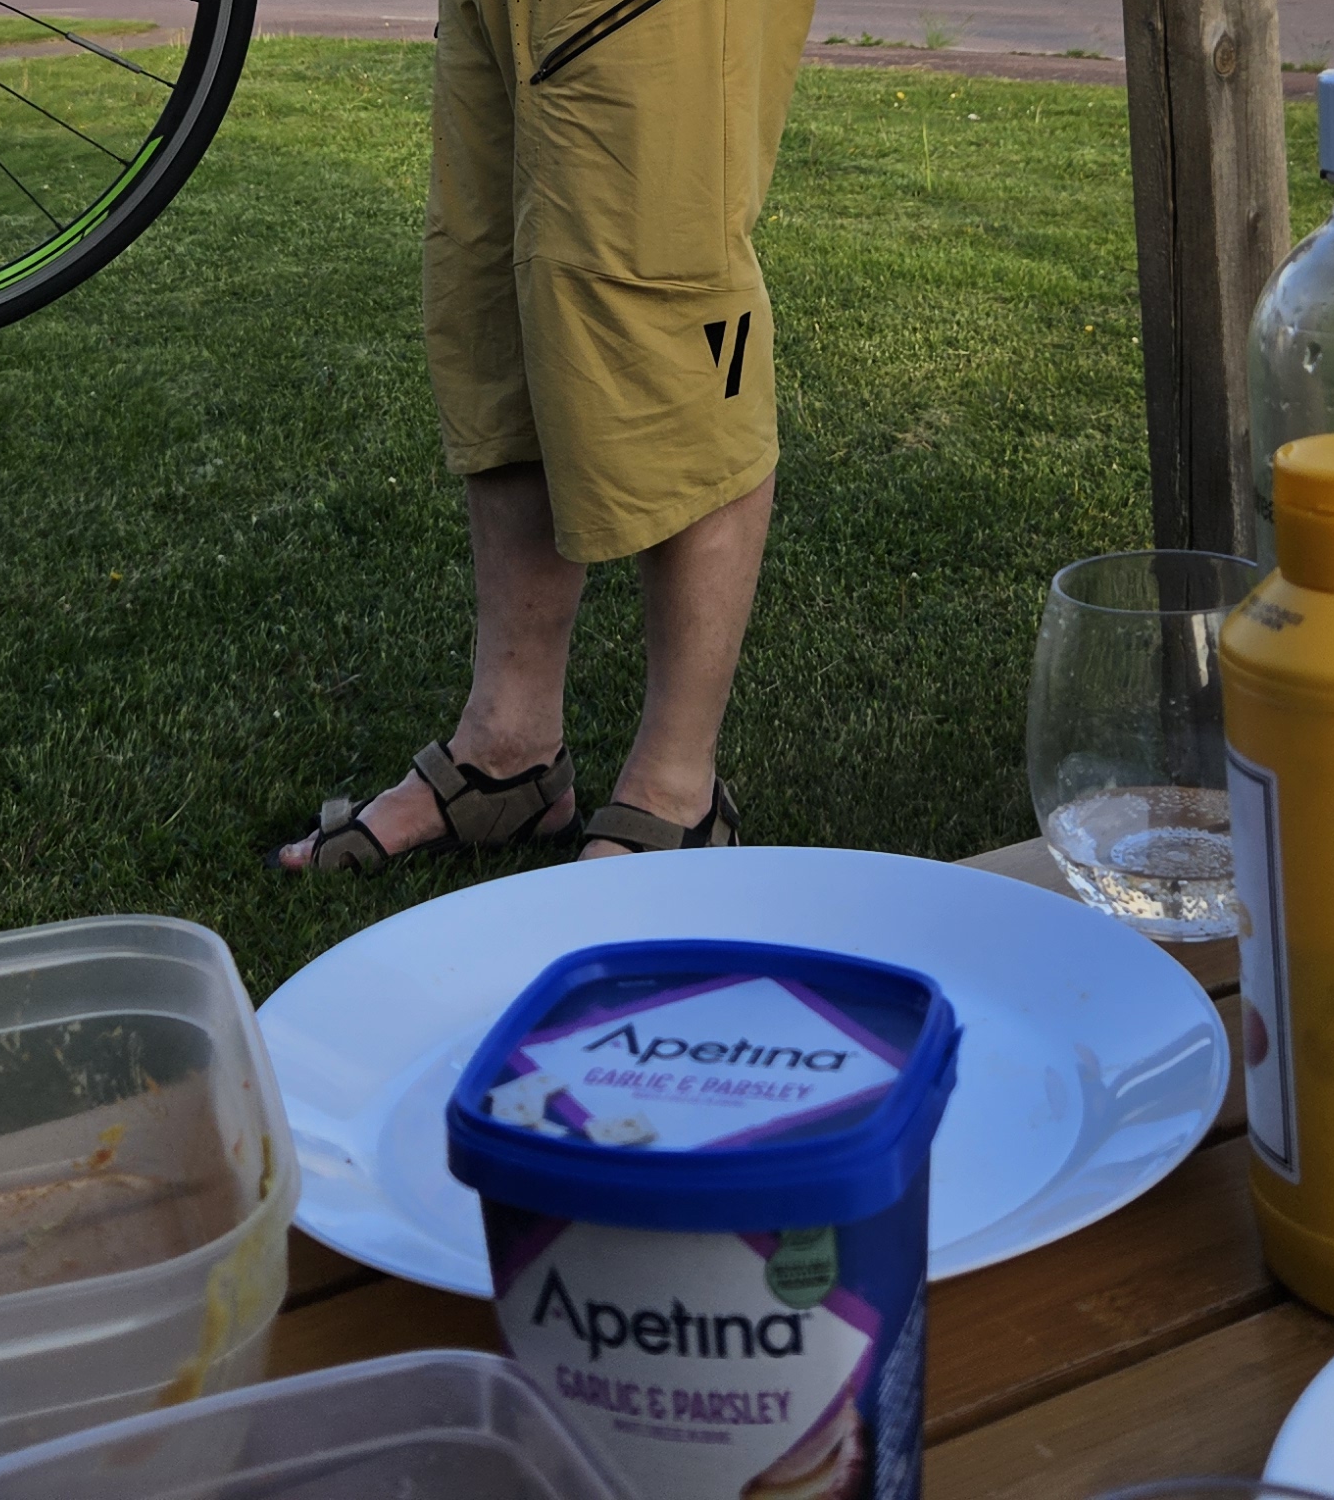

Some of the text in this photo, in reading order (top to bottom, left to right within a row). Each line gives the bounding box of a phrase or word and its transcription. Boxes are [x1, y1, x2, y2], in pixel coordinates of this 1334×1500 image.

[583, 1023, 848, 1074] Apetina
[583, 1066, 675, 1092] GARLIC
[699, 1076, 814, 1100] PARSLEY
[532, 1266, 806, 1360] Apetina
[556, 1364, 641, 1416] GARLIC
[672, 1387, 793, 1425] PARSLEY
